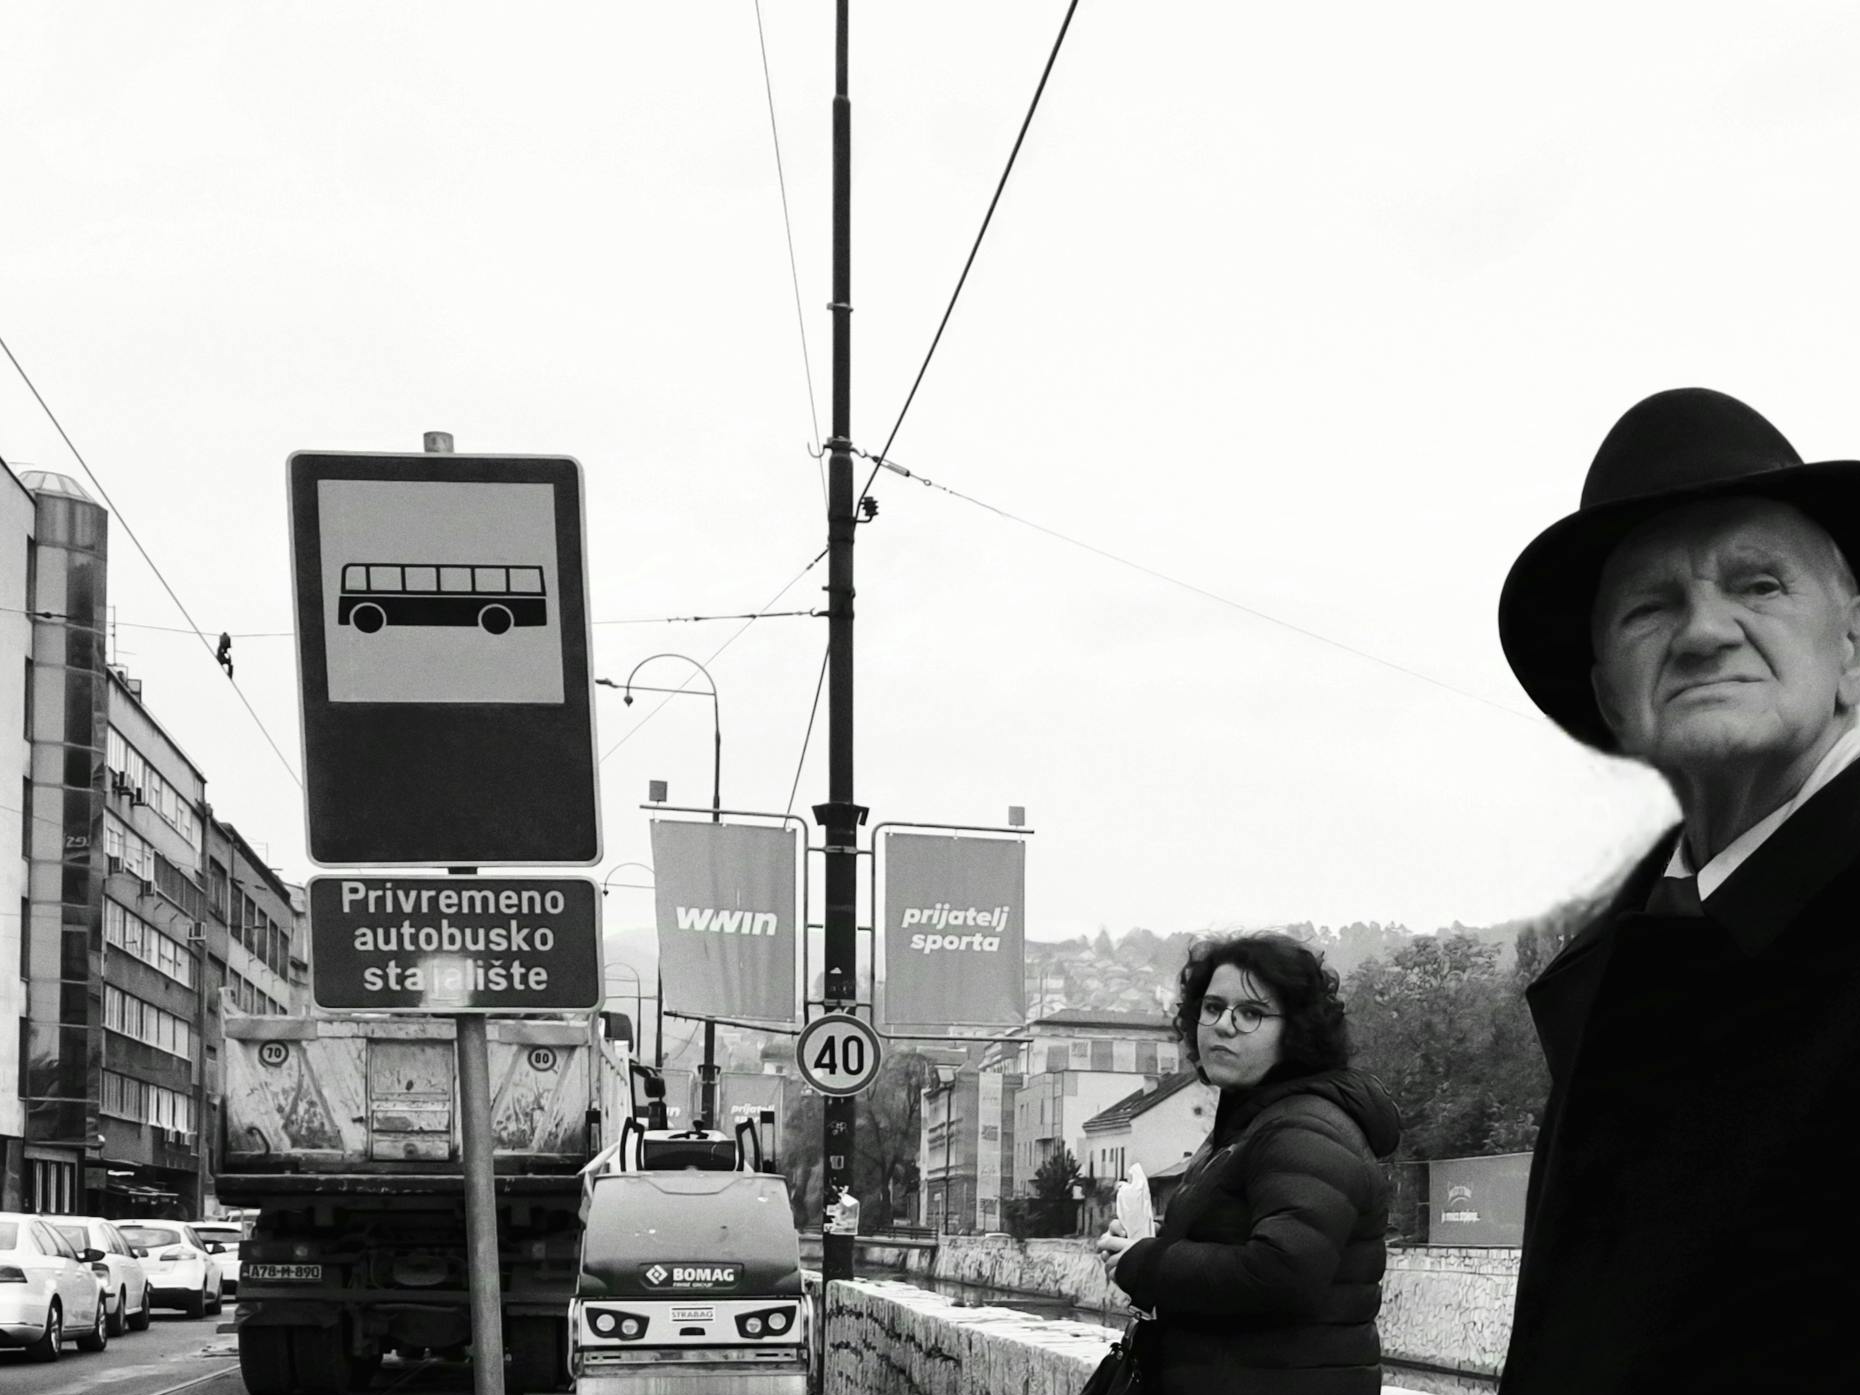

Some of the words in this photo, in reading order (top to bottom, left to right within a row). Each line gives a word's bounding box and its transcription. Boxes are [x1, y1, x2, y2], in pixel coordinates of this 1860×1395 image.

[341, 881, 565, 914] Privremeno
[676, 907, 778, 936] wwin
[902, 903, 1010, 931] prijatelj
[354, 919, 555, 951] autobusko
[910, 932, 1001, 954] sporta
[266, 1047, 283, 1059] 70
[814, 1035, 864, 1075] 40
[673, 1268, 735, 1281] BOMAG
